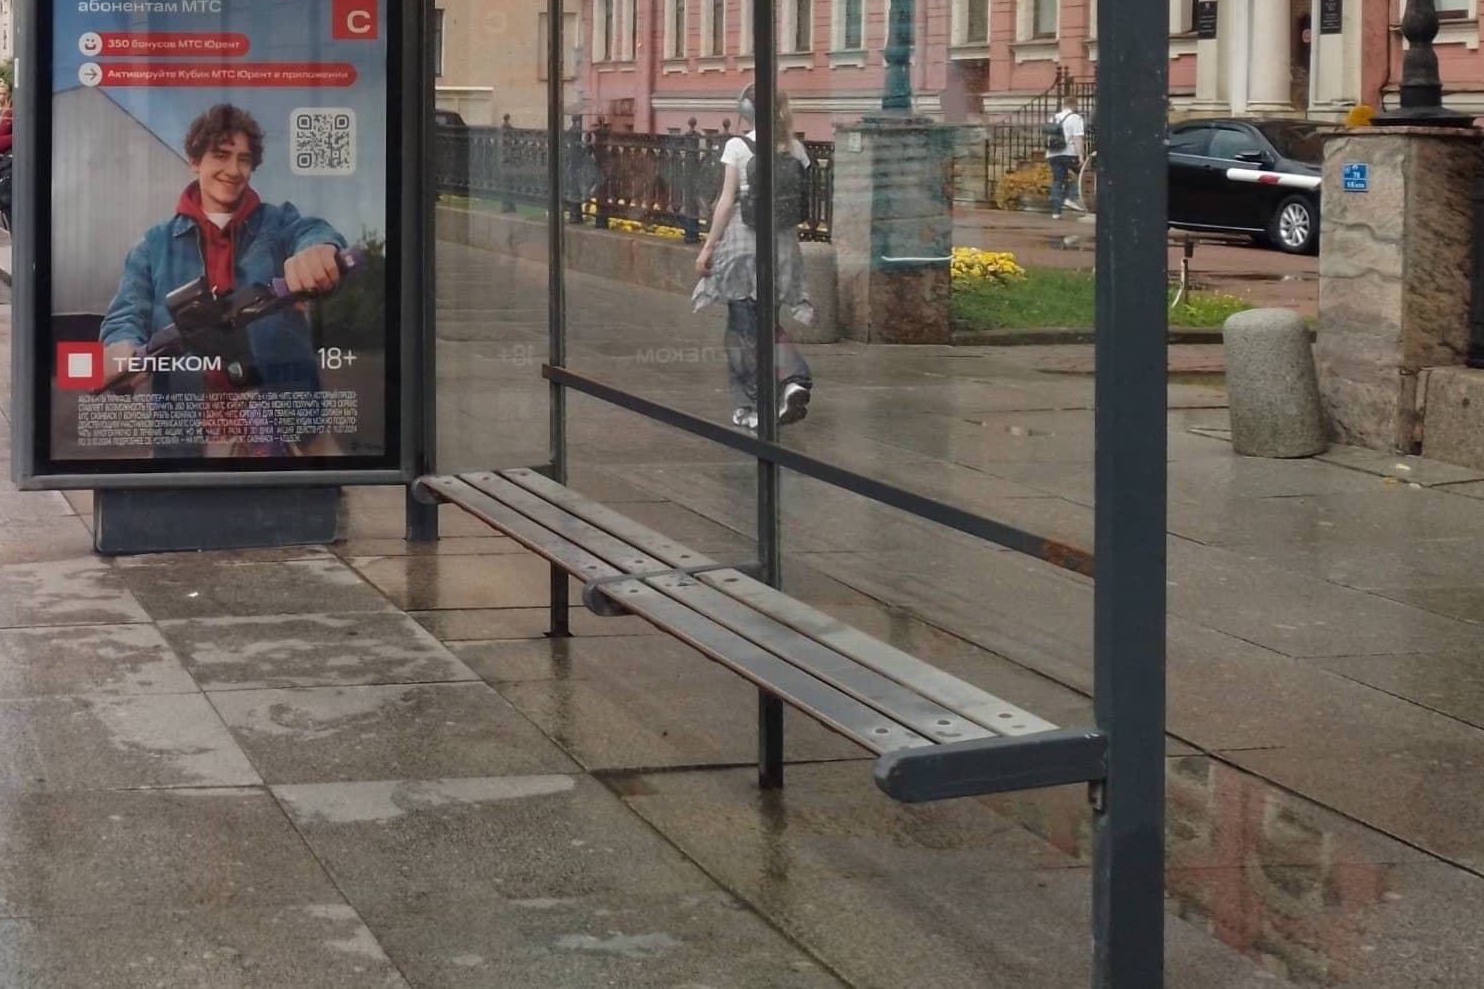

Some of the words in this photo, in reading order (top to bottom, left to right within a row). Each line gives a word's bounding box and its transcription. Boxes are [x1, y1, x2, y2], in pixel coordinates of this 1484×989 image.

[182, 0, 222, 13] МТС
[108, 39, 130, 48] 350
[132, 39, 176, 50] бонусов
[178, 40, 203, 49] МТС
[205, 40, 240, 50] Юрент
[108, 69, 177, 81] Активируйте
[179, 69, 210, 80] Кубик
[212, 70, 236, 79] МТС
[237, 70, 272, 80] Юрент
[113, 356, 222, 372] ТЕЛЕКОМ
[317, 348, 357, 370] 18+
